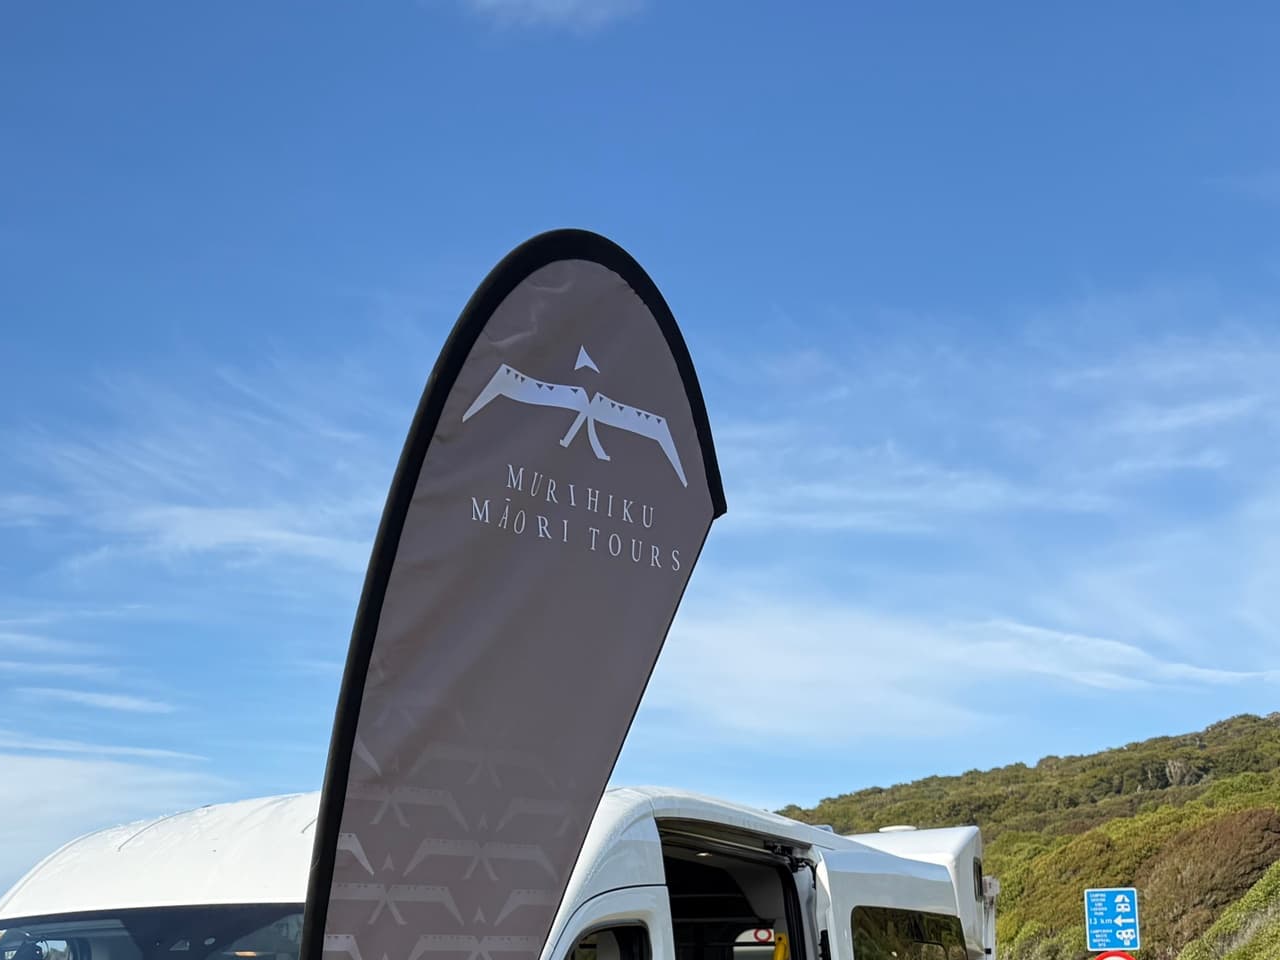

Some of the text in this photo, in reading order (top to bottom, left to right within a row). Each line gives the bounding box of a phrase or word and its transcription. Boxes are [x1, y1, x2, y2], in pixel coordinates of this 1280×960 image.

[506, 464, 654, 529] MURIHIKU
[471, 497, 681, 571] MĀORI TOURS
[1100, 917, 1113, 925] km
